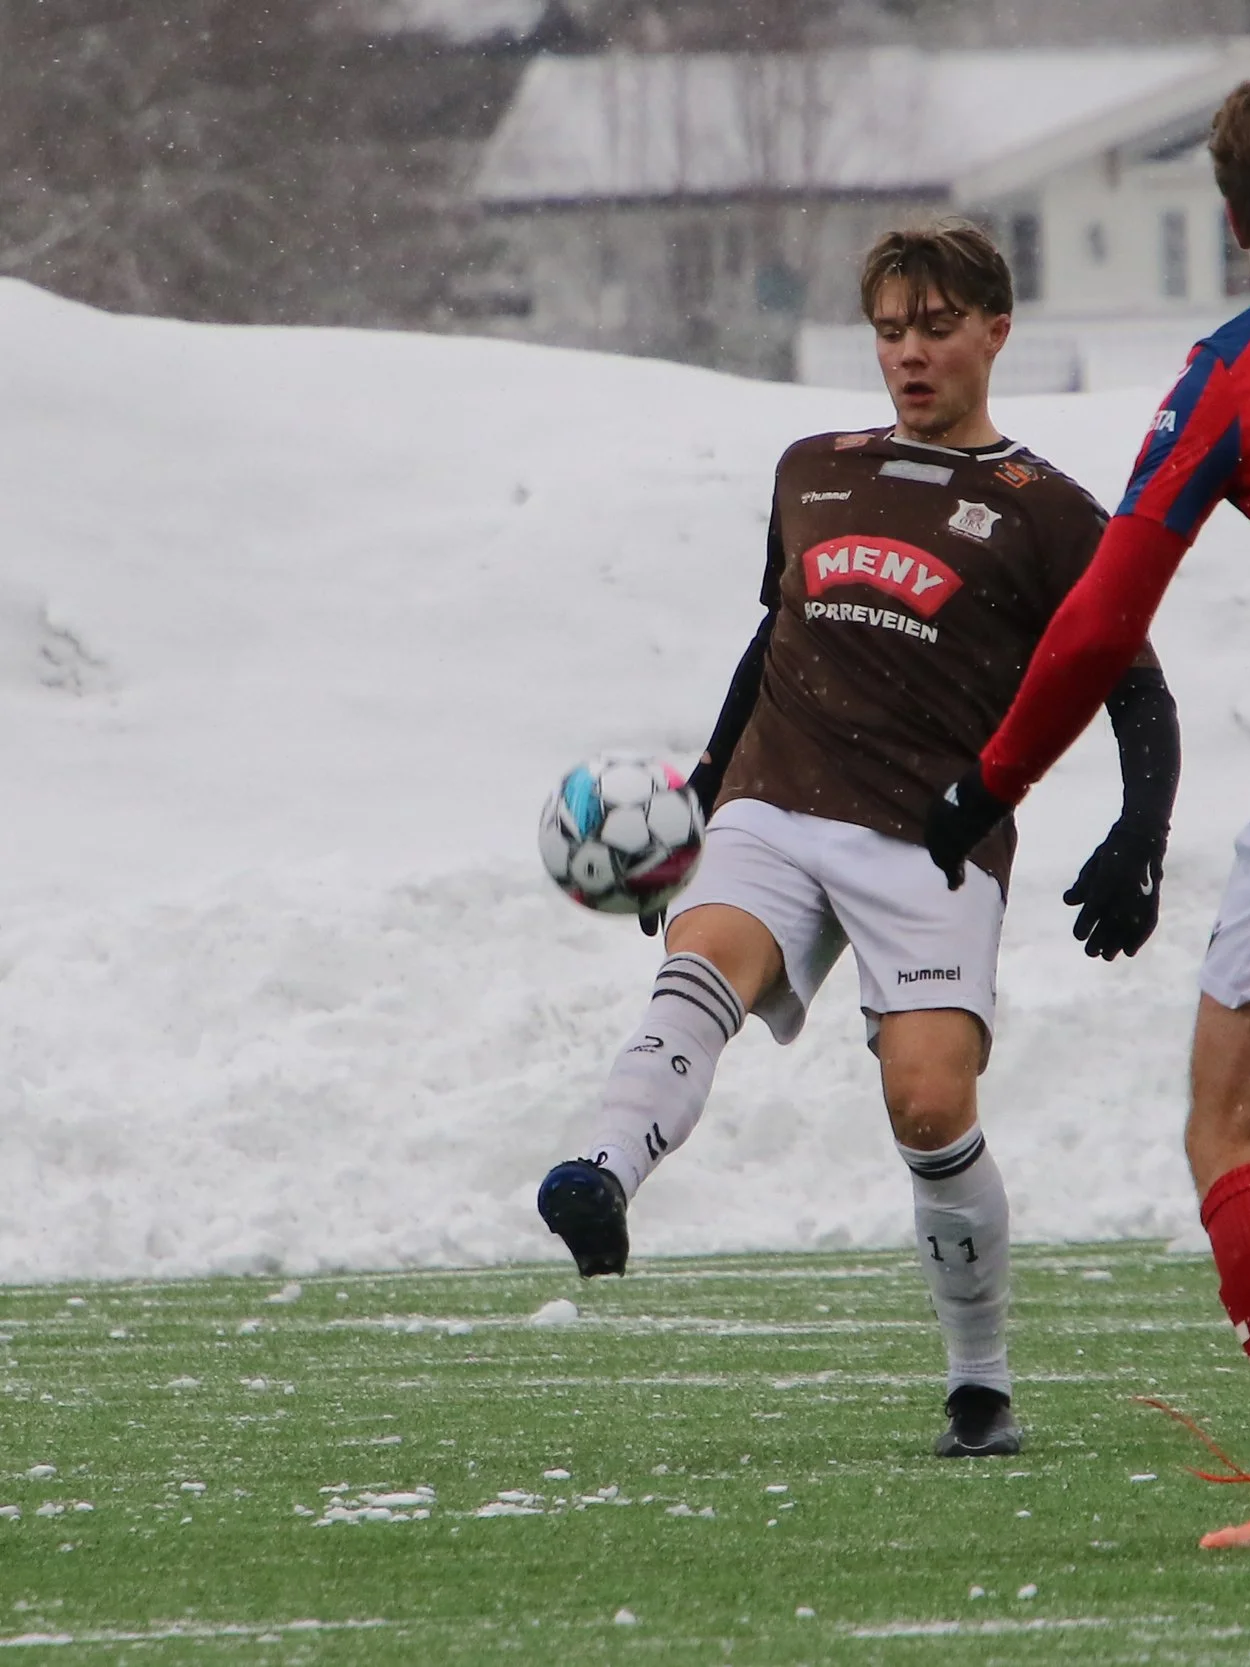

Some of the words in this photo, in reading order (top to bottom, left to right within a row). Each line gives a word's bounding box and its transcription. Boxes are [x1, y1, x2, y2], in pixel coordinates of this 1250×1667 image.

[810, 490, 852, 502] hummel
[816, 545, 944, 596] MENY
[897, 965, 961, 985] hummel
[927, 1235, 978, 1263] 11
